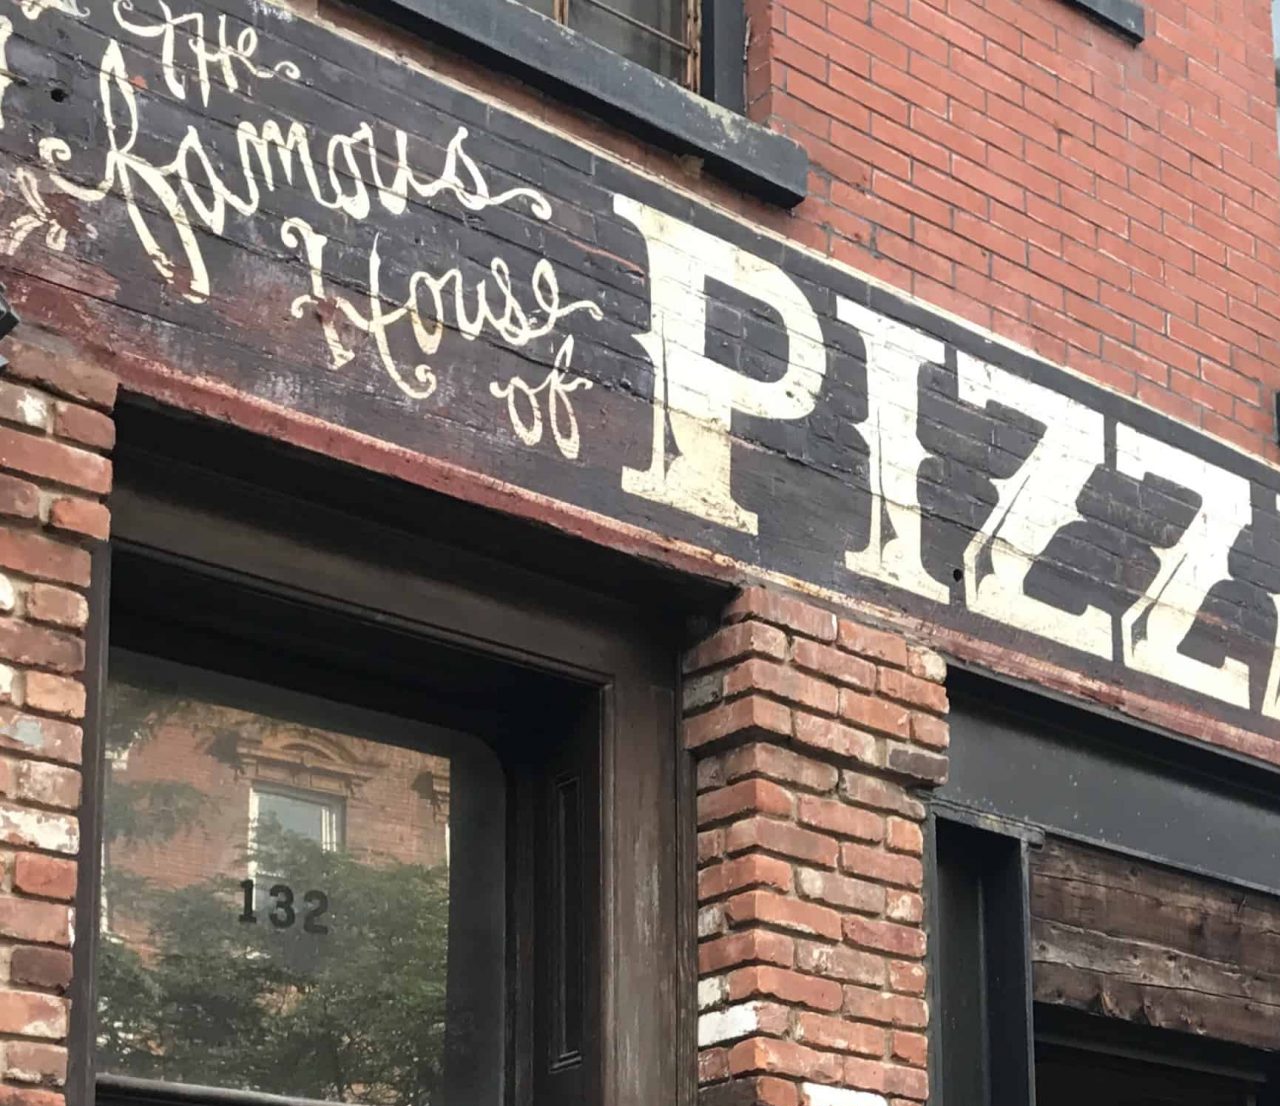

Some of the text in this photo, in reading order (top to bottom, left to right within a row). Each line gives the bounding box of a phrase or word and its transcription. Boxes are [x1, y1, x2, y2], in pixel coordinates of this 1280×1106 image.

[38, 38, 552, 302] Famous
[281, 217, 603, 399] House
[490, 334, 593, 460] of
[238, 879, 329, 935] 132
